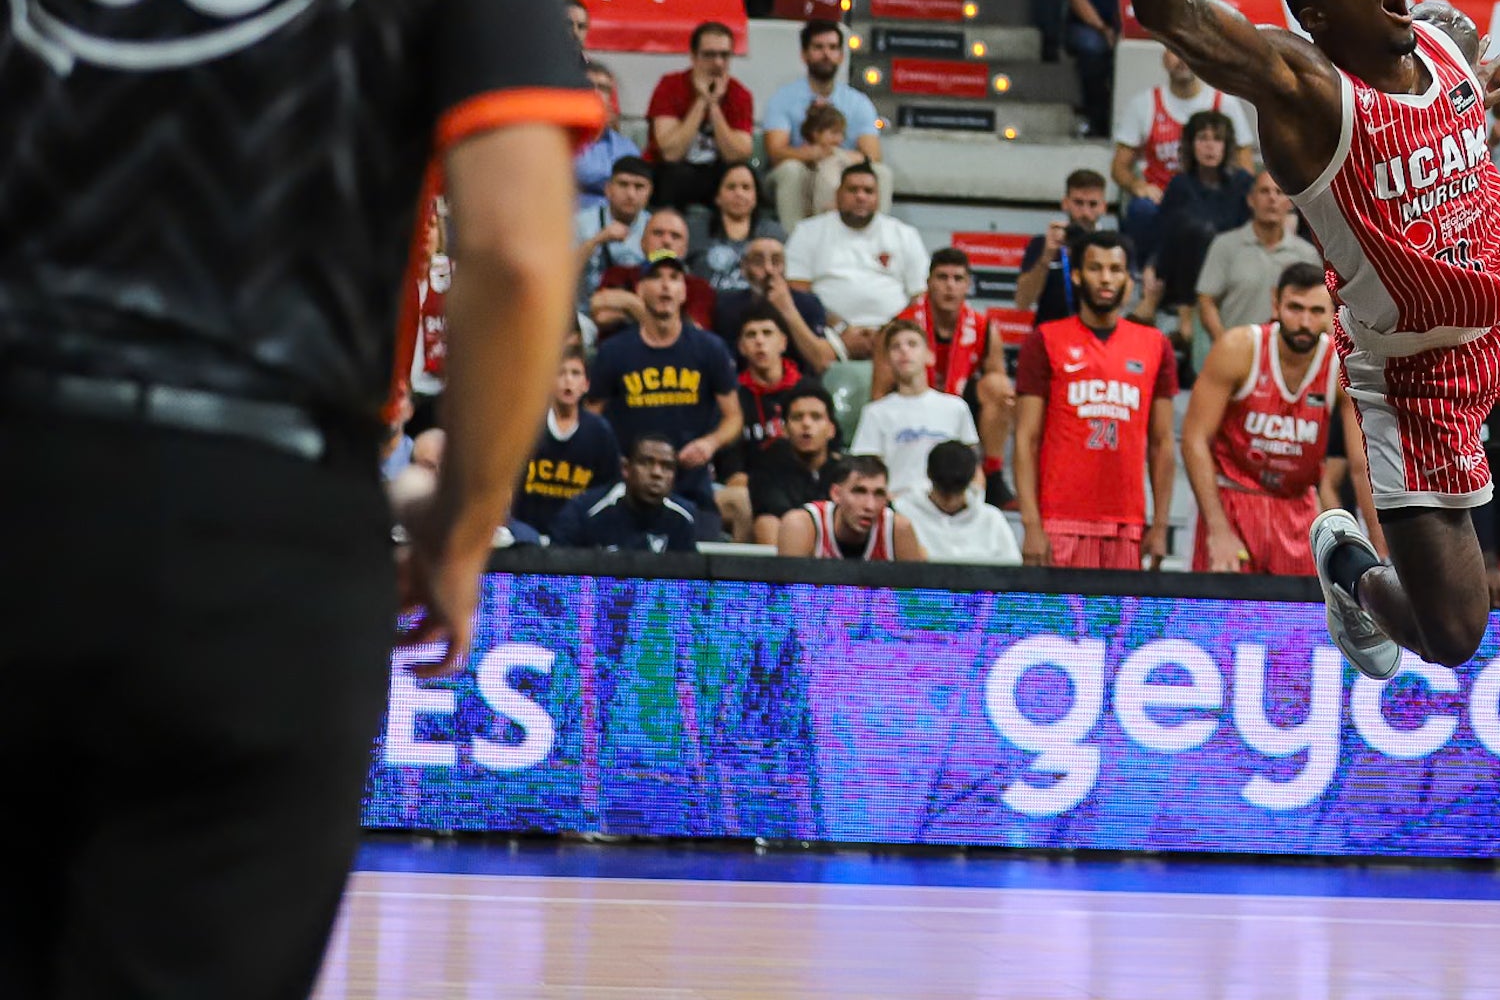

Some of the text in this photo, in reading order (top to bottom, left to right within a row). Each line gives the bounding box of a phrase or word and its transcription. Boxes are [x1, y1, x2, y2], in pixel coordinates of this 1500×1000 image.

[1374, 126, 1488, 200] UCAM
[1402, 173, 1480, 222] MURCIA
[623, 365, 701, 396] UCAM
[1068, 379, 1140, 411] UCAM
[1088, 419, 1118, 450] 24
[1244, 411, 1319, 445] UCAM
